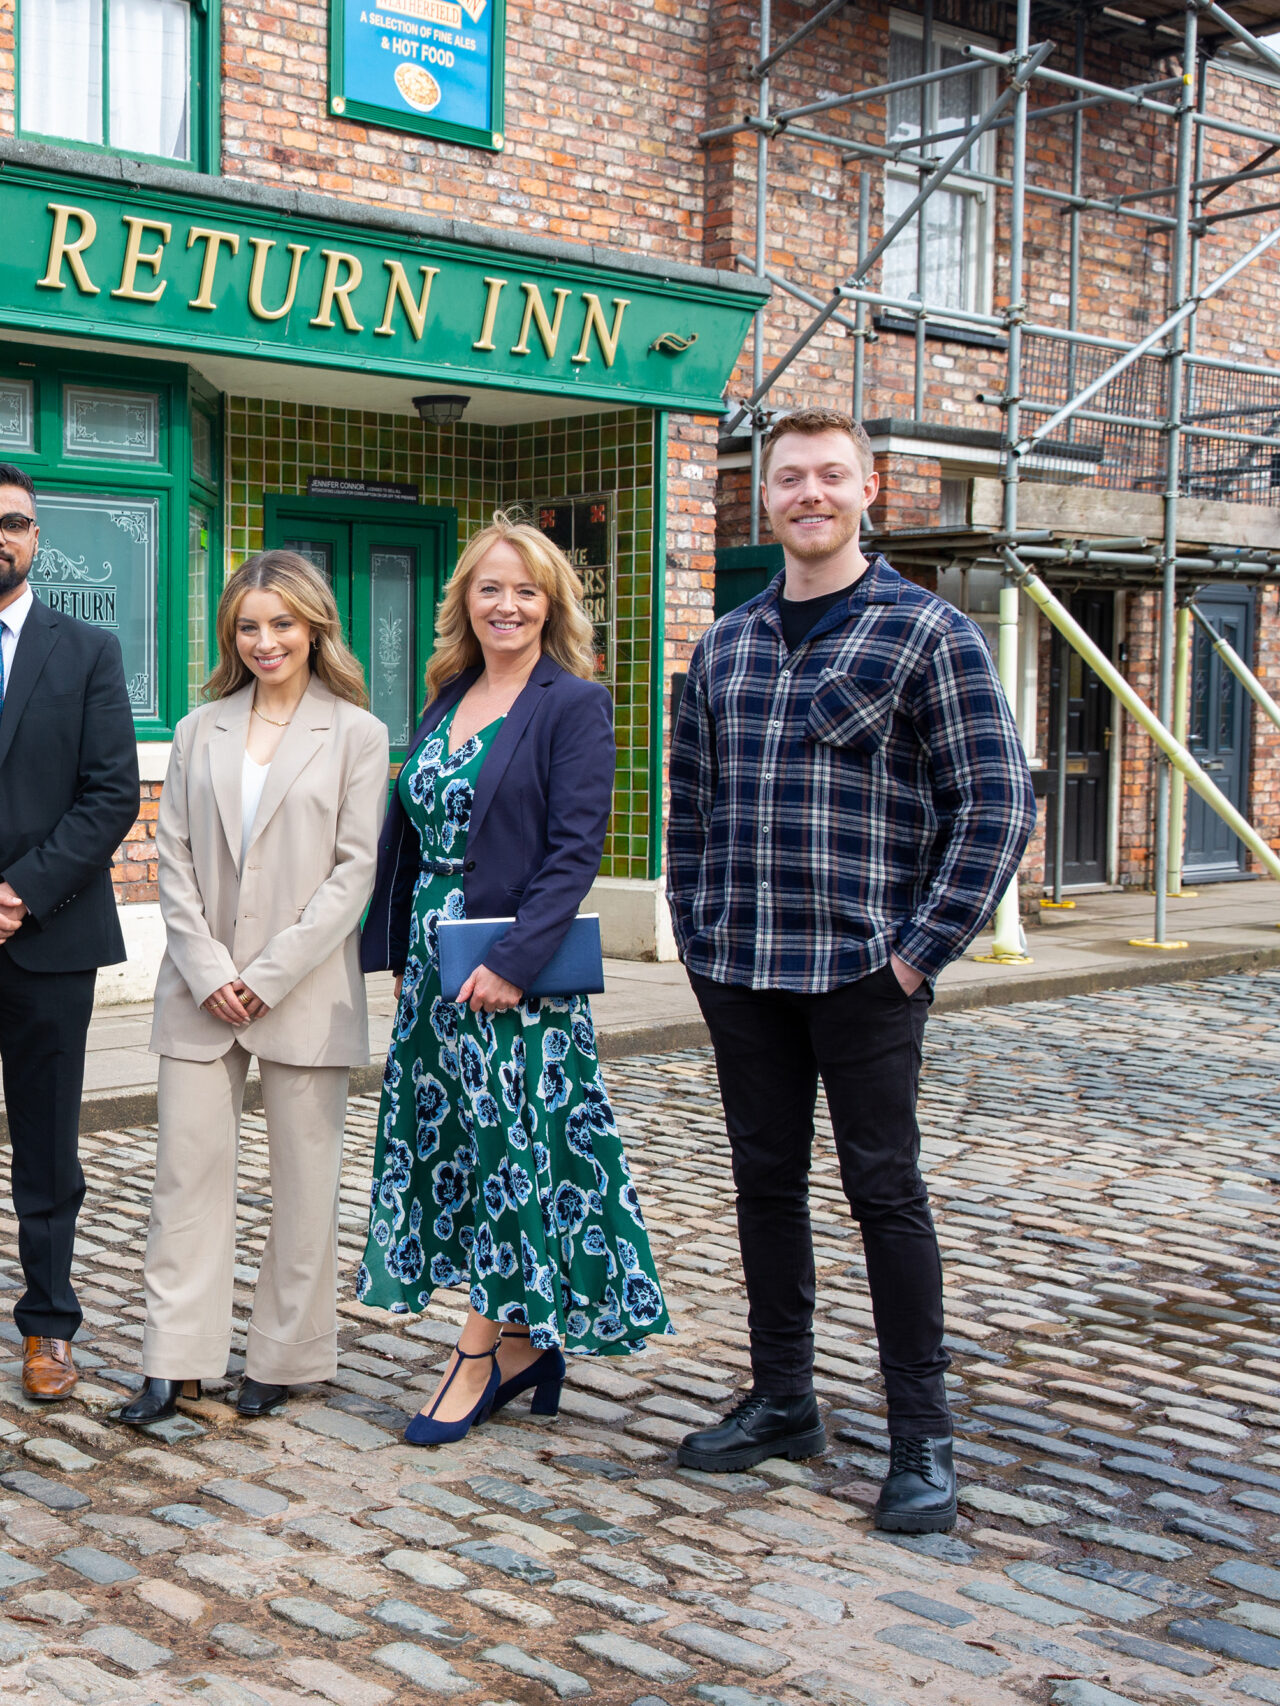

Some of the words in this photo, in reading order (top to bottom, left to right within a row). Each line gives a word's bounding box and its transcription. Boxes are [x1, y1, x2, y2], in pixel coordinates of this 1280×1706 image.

[360, 11, 367, 23] A
[369, 12, 418, 36] SELECTION
[420, 26, 432, 38] OF
[433, 29, 452, 45] FINE
[454, 35, 476, 51] ALES
[381, 36, 390, 50] &
[392, 37, 419, 58] HOT
[421, 44, 455, 68] FOOD
[36, 202, 441, 341] RETURN
[472, 276, 632, 368] INN
[311, 479, 339, 489] JENNIFER
[340, 482, 365, 491] CONNOR
[564, 548, 588, 566] HE
[48, 588, 117, 622] RETURN
